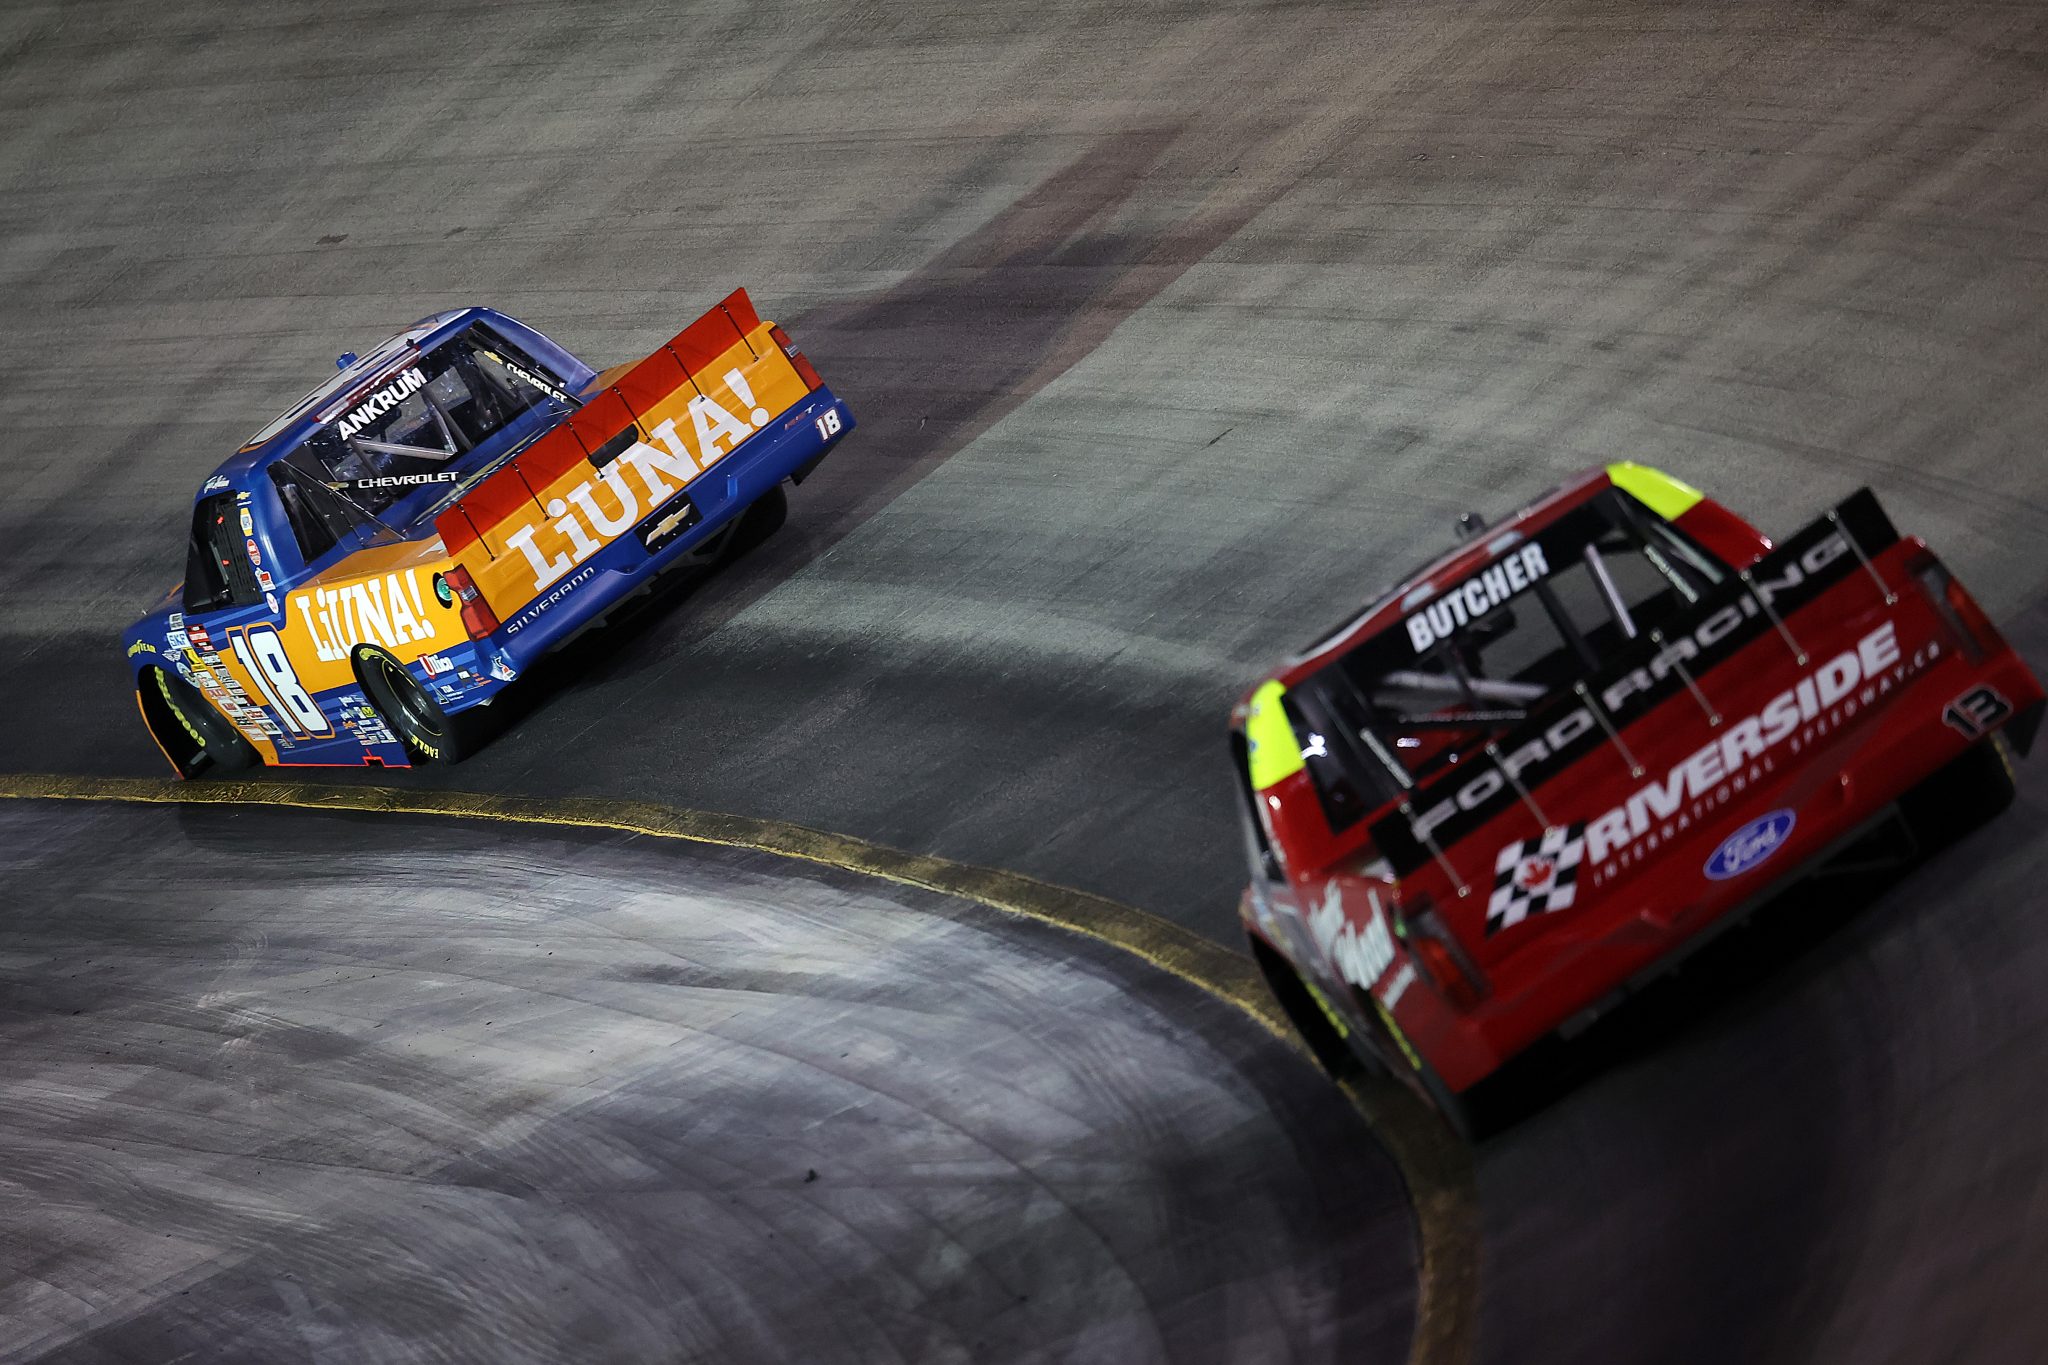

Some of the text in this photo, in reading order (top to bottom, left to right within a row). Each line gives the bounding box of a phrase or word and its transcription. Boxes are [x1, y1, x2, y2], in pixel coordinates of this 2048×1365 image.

[337, 367, 427, 441] ANKRUM
[506, 362, 567, 404] CHEVROLET
[815, 407, 841, 441] 18
[358, 471, 459, 489] CHEVROLET
[506, 367, 770, 592] LiUNA!
[295, 569, 436, 663] LiUNA!
[506, 566, 594, 636] SILVERADO
[1405, 542, 1551, 654] BUTCHER
[226, 623, 335, 739] 18
[1411, 531, 1851, 842] FORD RACING
[1942, 684, 2010, 740] 13
[411, 734, 439, 759] EAGLE
[1584, 620, 1901, 866] RIVERSIDE
[1593, 756, 1776, 888] INTERNATIONAL
[1721, 818, 1779, 874] Ford
